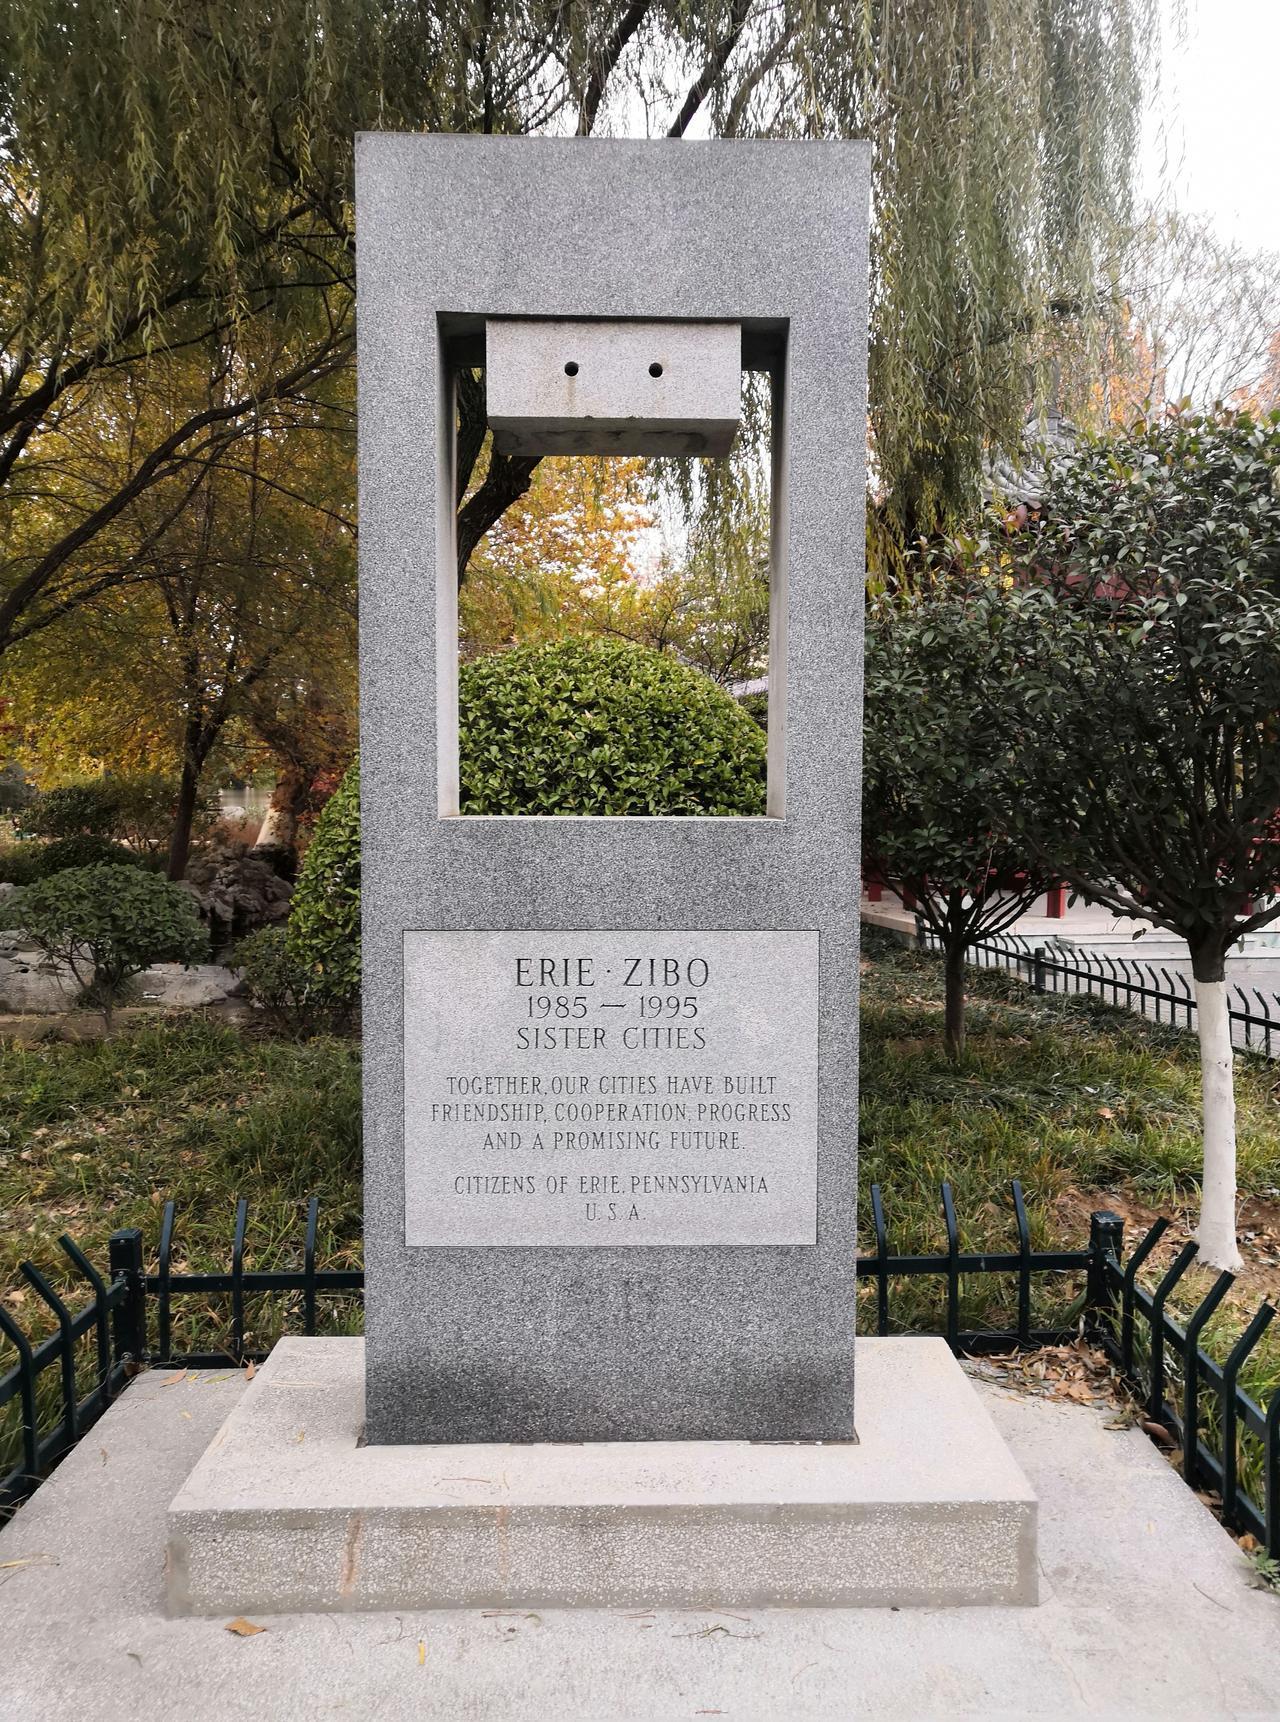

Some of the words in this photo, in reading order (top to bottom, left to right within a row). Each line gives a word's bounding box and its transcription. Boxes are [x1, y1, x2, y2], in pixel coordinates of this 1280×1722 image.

[515, 957, 595, 988] ERIE
[622, 957, 710, 988] ZIBO
[527, 995, 588, 1019] 1985
[639, 995, 699, 1019] 1995
[516, 1026, 607, 1051] SISTER
[622, 1026, 707, 1051] CITIES
[551, 1075, 590, 1096] OUR
[599, 1075, 657, 1095] CITIES
[667, 1075, 714, 1095] HAVE
[723, 1075, 777, 1095] BUILT
[431, 1103, 548, 1124] FRIENDSHIP,
[697, 1103, 792, 1123] PROGRESS
[482, 1131, 522, 1151] AND
[532, 1132, 545, 1151] A
[554, 1130, 661, 1151] PROMISING
[670, 1131, 746, 1151] FUTURE.
[454, 1175, 536, 1195] CITIZENS
[546, 1175, 569, 1195] OF
[630, 1175, 769, 1195] PENNSYLVANIA
